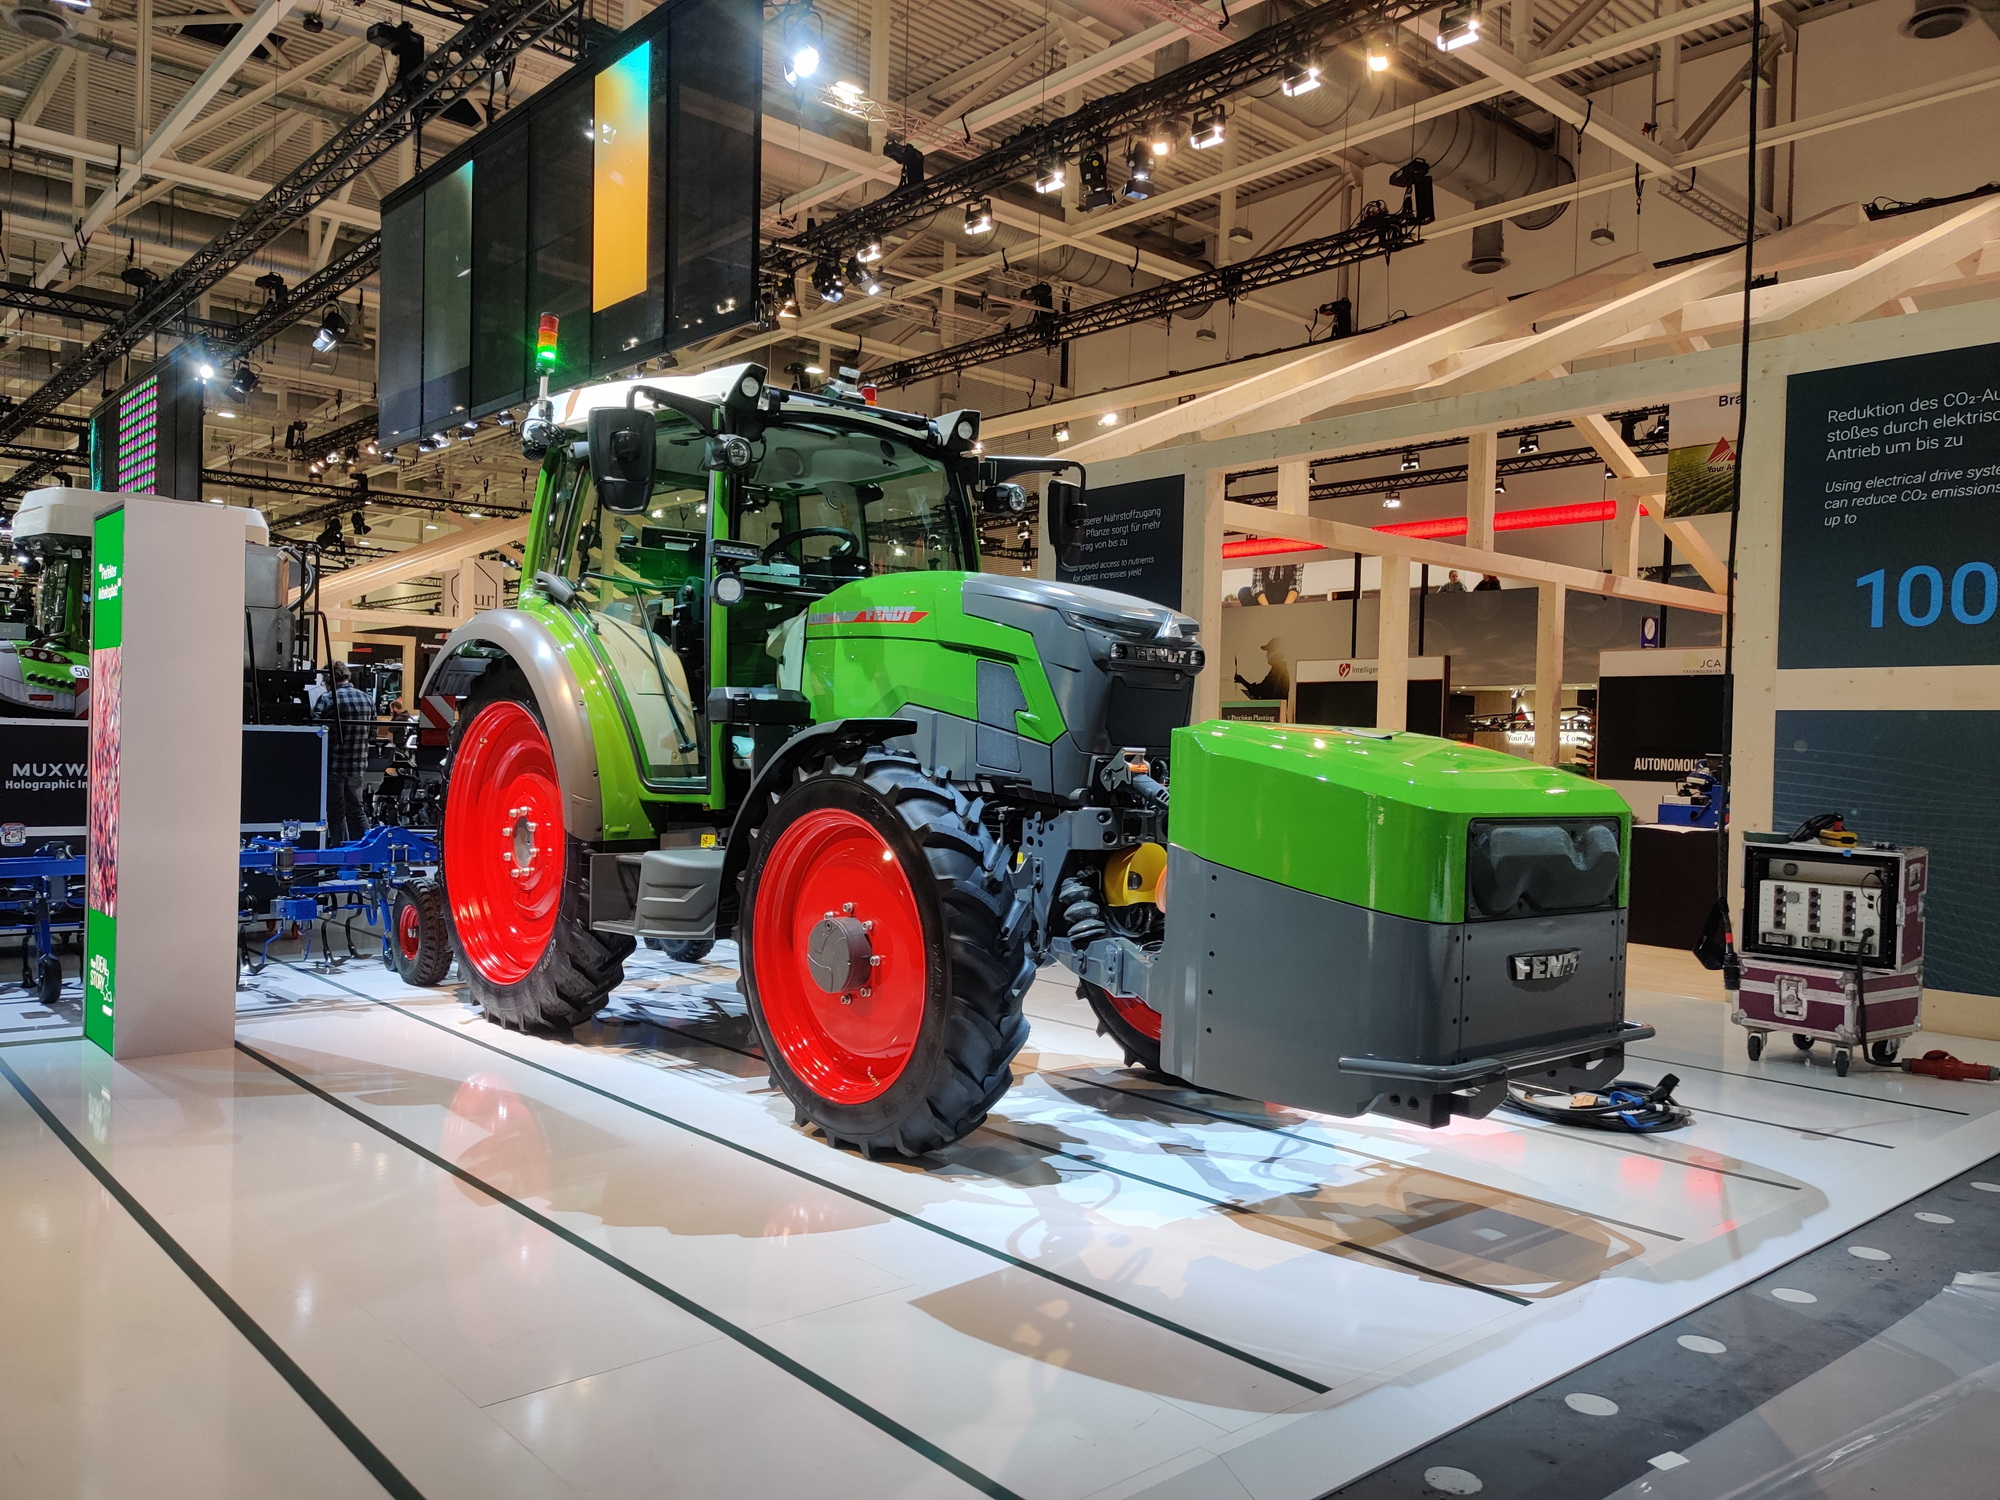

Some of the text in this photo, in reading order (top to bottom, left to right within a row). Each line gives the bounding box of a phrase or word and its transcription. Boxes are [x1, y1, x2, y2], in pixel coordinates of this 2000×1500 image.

[1828, 403, 1905, 423] Reduktion
[1909, 397, 1939, 412] des
[1827, 425, 1879, 443] stoßes
[1883, 417, 1928, 436] durch
[1825, 435, 1963, 462] Antrieb um bis zu
[1825, 480, 1862, 494] Using
[1865, 470, 1926, 490] electrical
[1929, 468, 1963, 483] drive
[1824, 498, 1848, 510] can
[1851, 493, 1897, 508] reduce
[1931, 481, 2000, 500] emissions
[1103, 508, 1161, 523] Nährstoffzugang
[1824, 513, 1857, 528] up to
[1085, 520, 1161, 538] Pflanze sorgt für mehr
[1094, 541, 1107, 550] von
[1108, 538, 1118, 548] bis
[1119, 538, 1128, 547] zu
[1072, 573, 1080, 583] for
[1081, 572, 1099, 583] plants
[1856, 561, 1999, 629] 100
[865, 606, 916, 622] FENDT
[1700, 659, 1722, 668] JCA
[5, 779, 76, 791] Holographic
